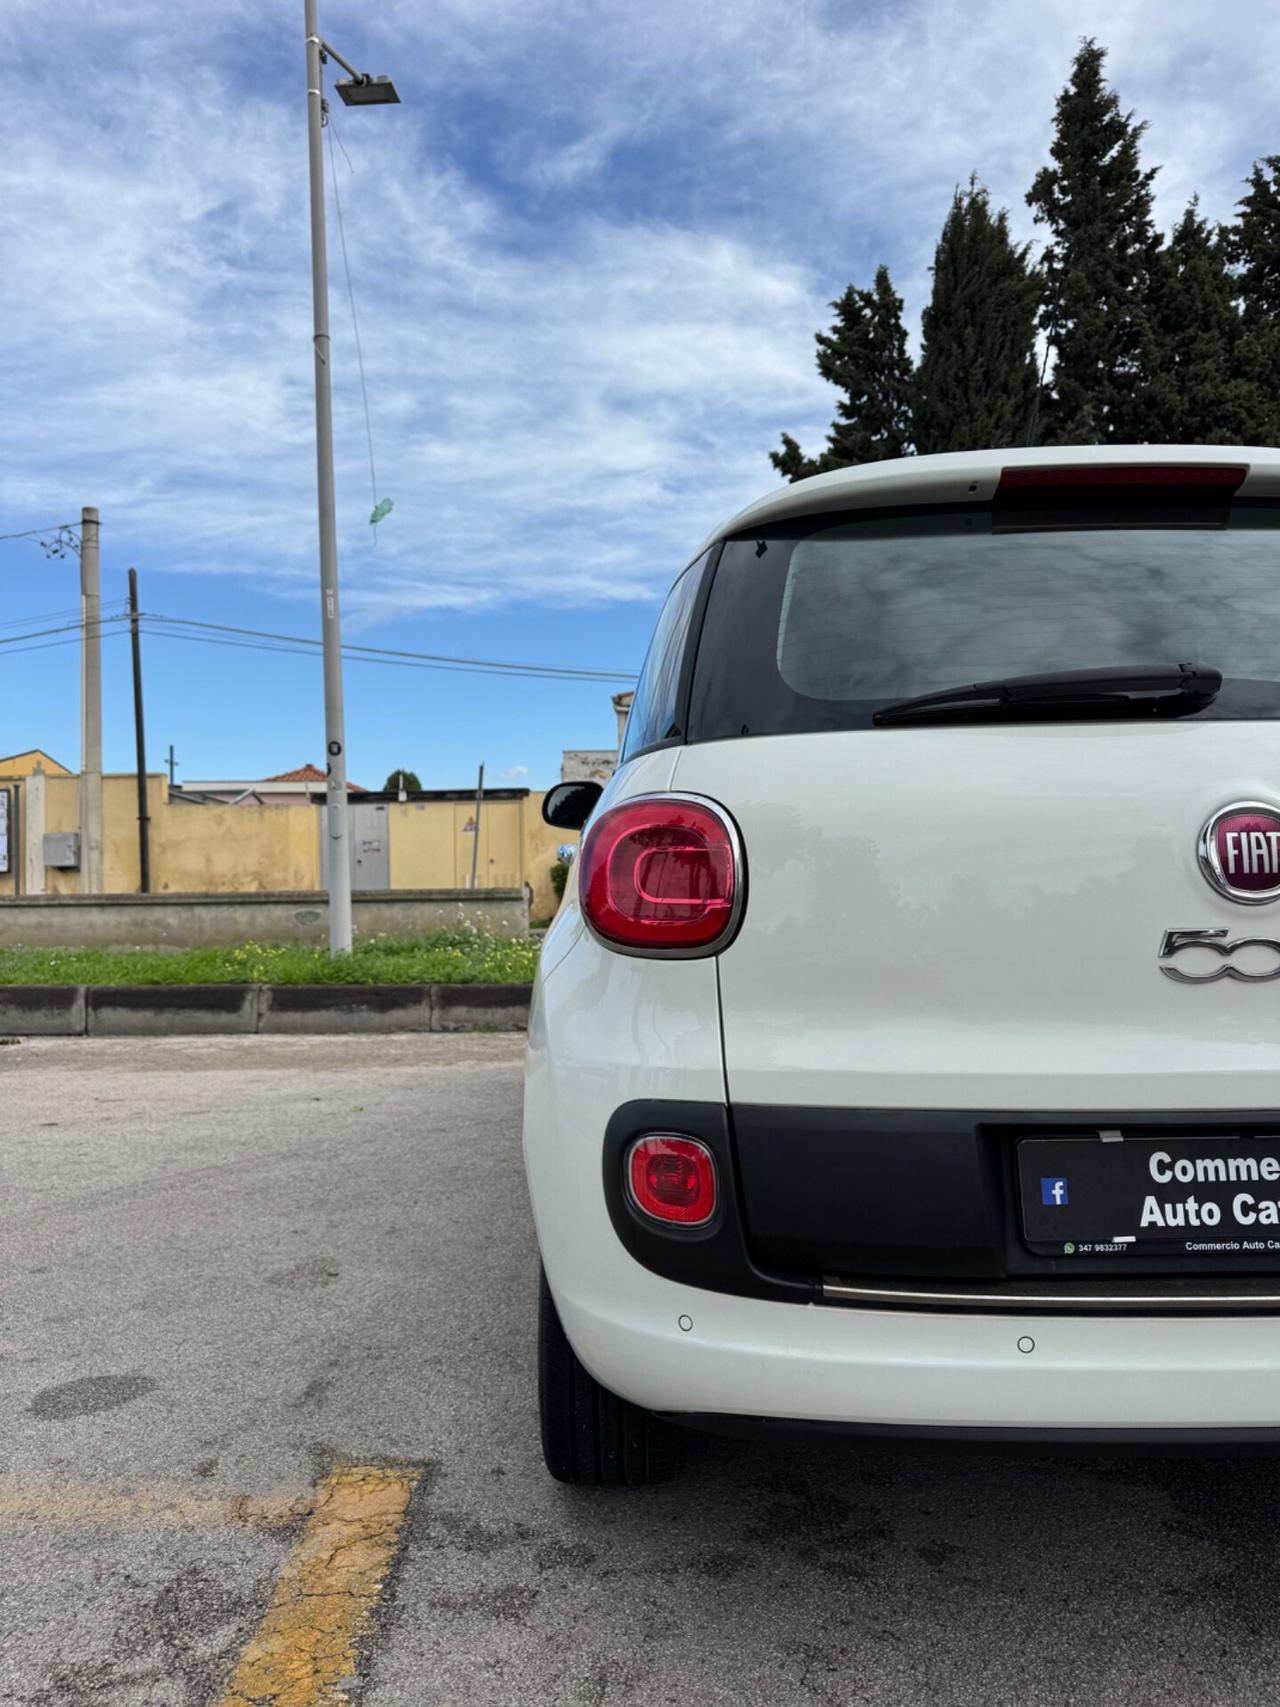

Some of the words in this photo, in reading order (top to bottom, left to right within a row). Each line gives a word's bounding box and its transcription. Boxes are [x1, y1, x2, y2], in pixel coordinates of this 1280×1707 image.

[1225, 832, 1280, 874] FIAT
[1149, 1151, 1280, 1184] Comme
[1140, 1194, 1221, 1227] Auto
[1232, 1192, 1280, 1225] Ca
[1078, 1243, 1092, 1252] 347
[1185, 1241, 1240, 1251] Commercio
[1242, 1240, 1265, 1250] Auto
